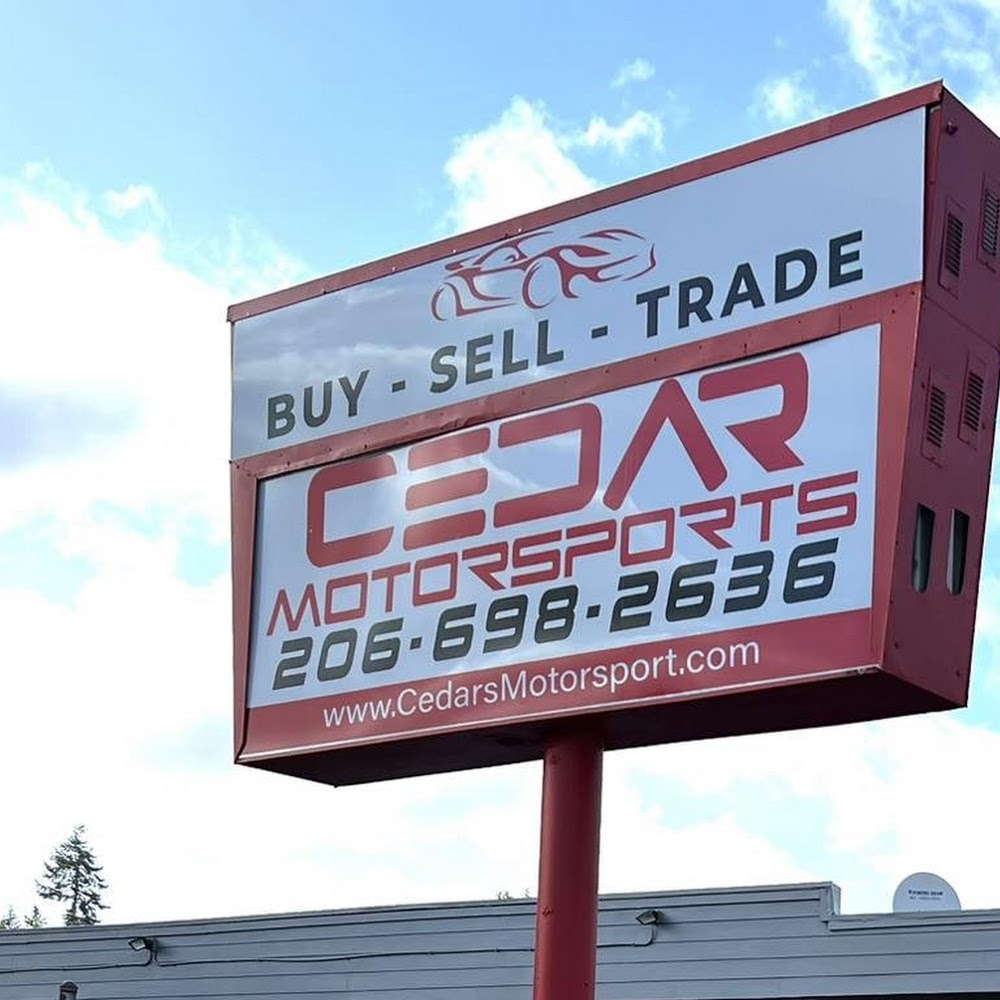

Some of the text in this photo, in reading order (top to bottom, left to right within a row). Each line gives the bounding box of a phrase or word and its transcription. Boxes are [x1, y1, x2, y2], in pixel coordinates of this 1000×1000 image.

[267, 370, 370, 440] BUY
[429, 320, 565, 394] SELL
[635, 229, 864, 339] TRADE
[266, 471, 859, 636] MOTORSPORTS
[306, 352, 808, 568] CEDAR
[322, 640, 761, 728] www.CedarsMotorsport.com
